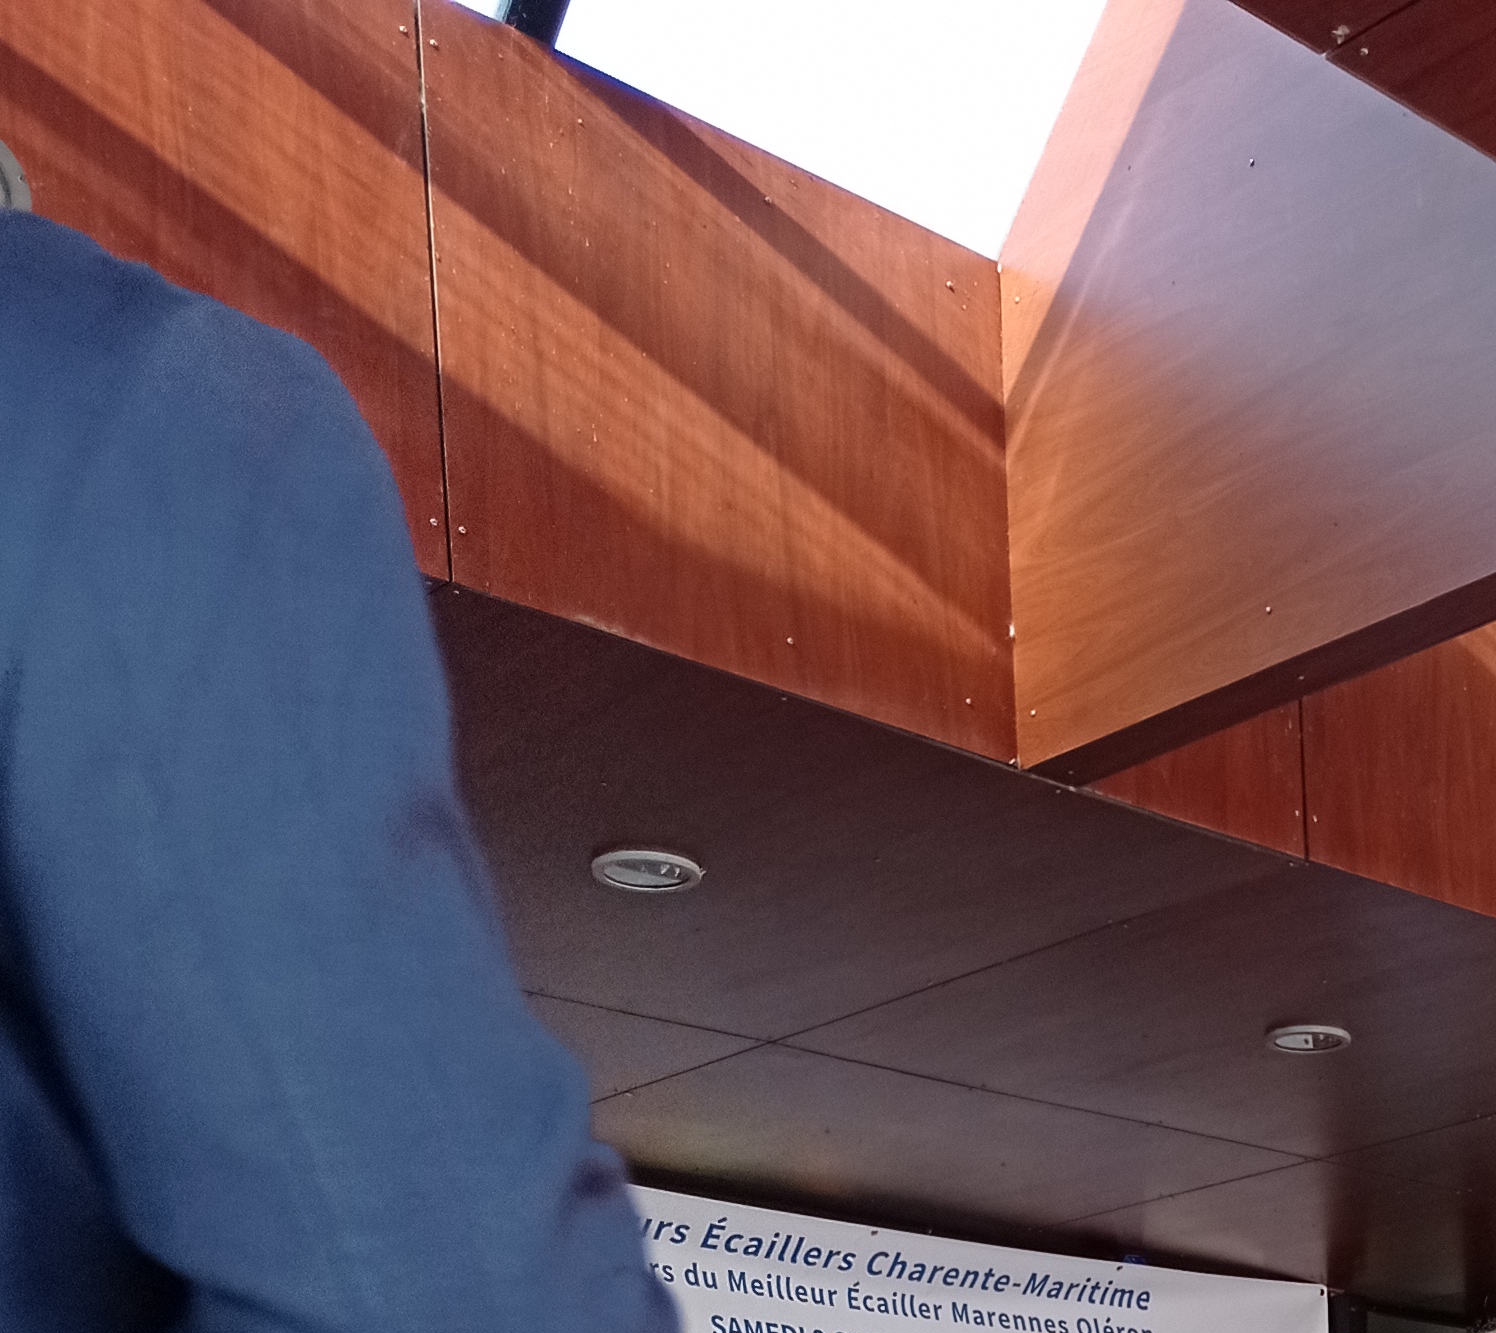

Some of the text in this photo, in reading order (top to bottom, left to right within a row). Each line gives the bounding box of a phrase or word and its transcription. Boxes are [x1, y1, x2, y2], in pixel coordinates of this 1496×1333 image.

[684, 1262, 718, 1290] du
[727, 1269, 838, 1307] Meilleur
[847, 1281, 942, 1321] Écailler
[699, 1216, 857, 1272] Écaillers
[866, 1250, 1151, 1311] Charente-Maritime
